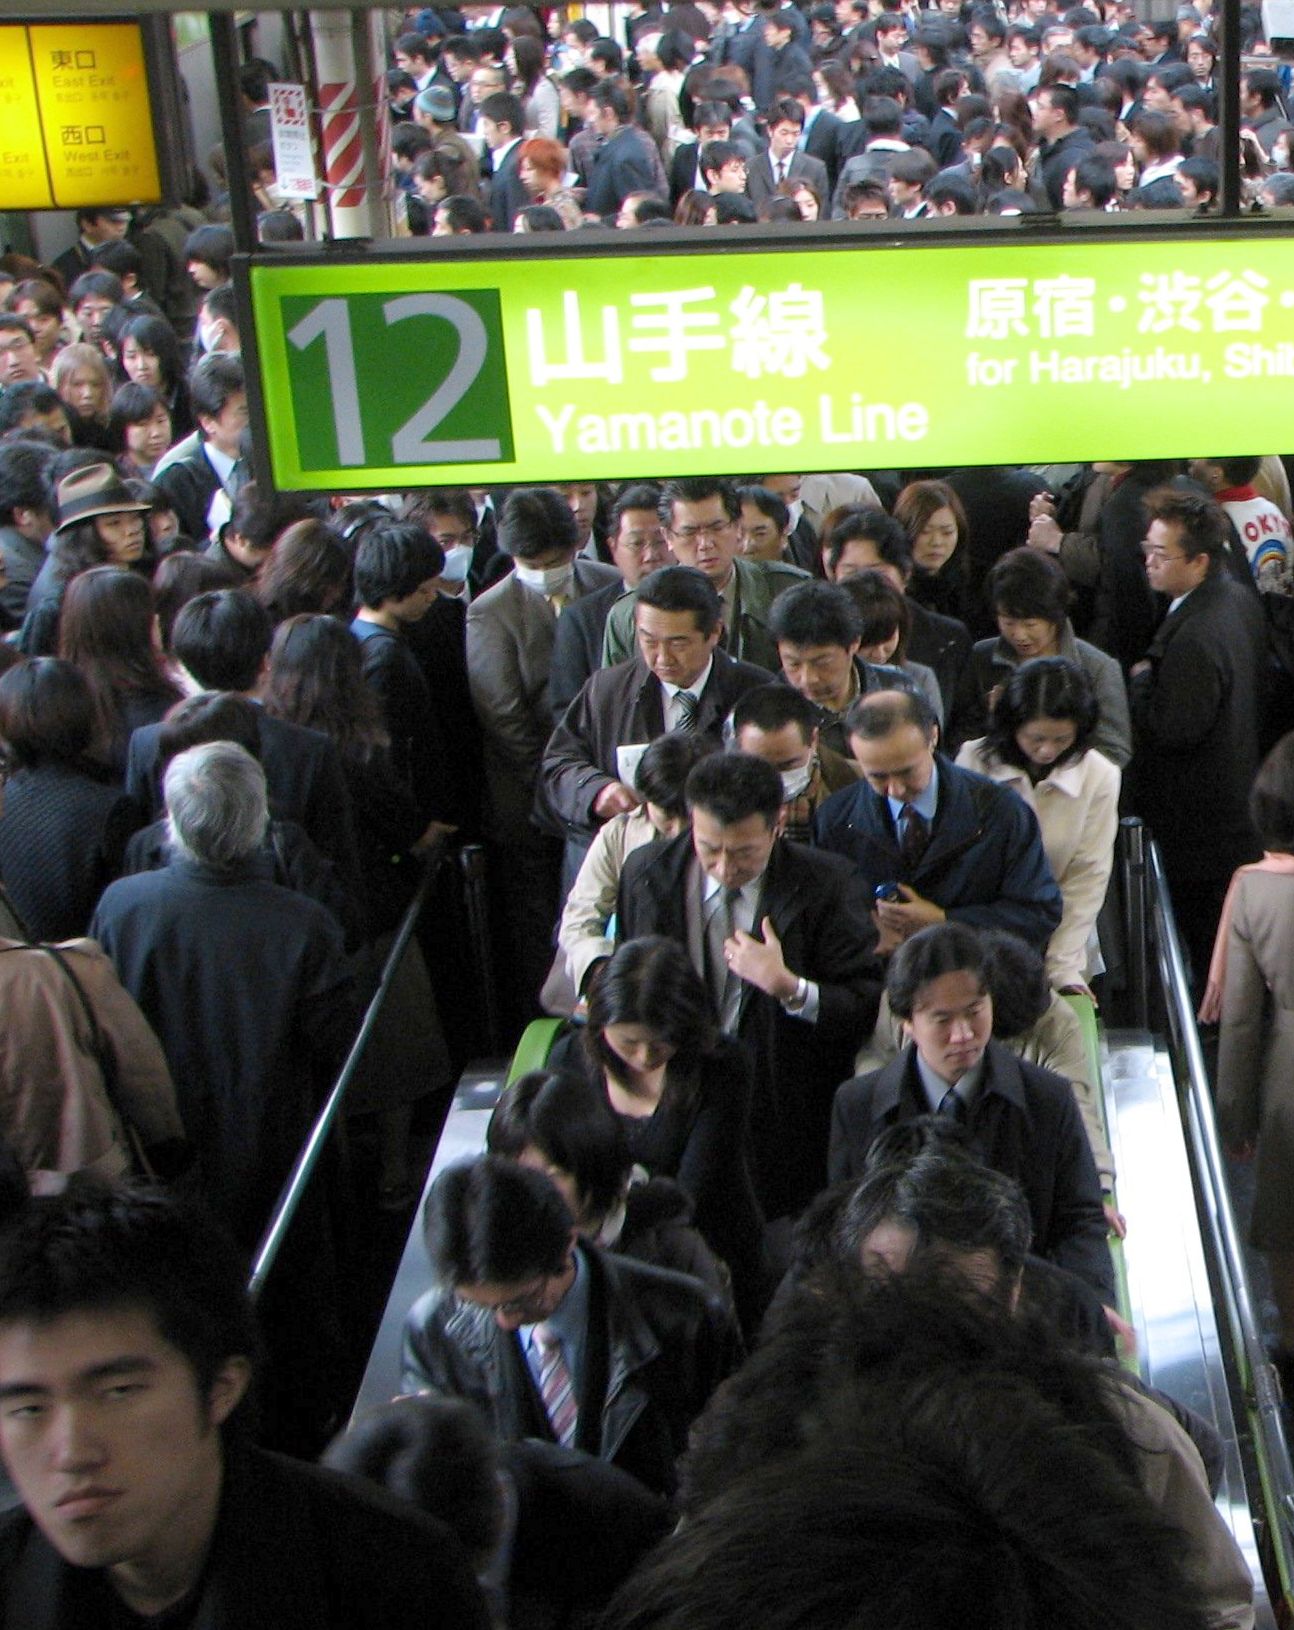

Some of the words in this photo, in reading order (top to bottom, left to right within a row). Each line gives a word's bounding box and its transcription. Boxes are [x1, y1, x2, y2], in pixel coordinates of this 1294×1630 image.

[51, 50, 96, 70] 東口
[53, 76, 84, 88] East
[88, 75, 116, 87] Exit
[60, 126, 106, 145] 西口
[64, 150, 99, 162] West
[104, 149, 131, 161] Exit
[527, 283, 832, 386] 山手線
[287, 292, 501, 466] 12
[965, 350, 1018, 386] for
[1029, 345, 1213, 389] Harajuku,
[536, 401, 802, 453] Yamanote
[820, 394, 929, 443] Line
